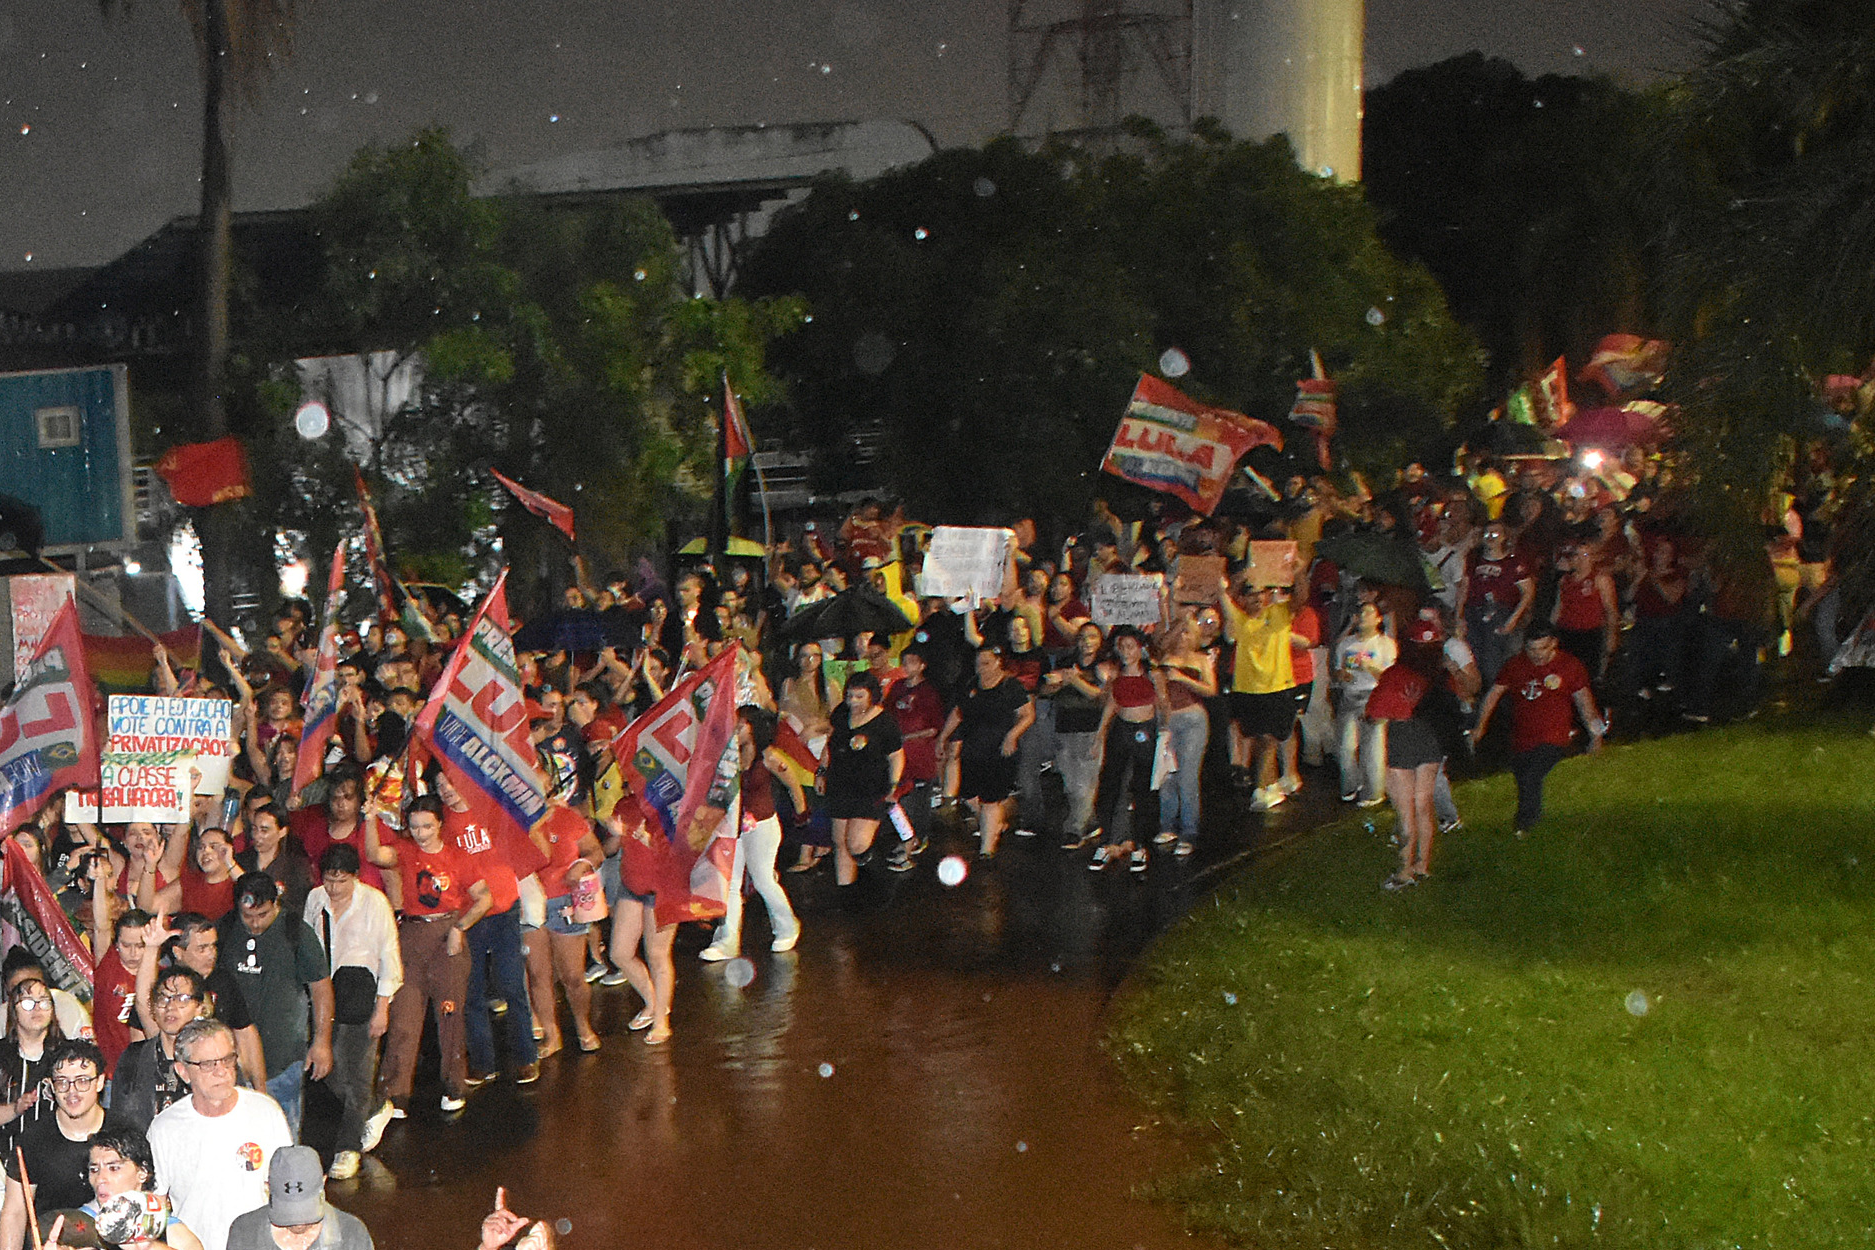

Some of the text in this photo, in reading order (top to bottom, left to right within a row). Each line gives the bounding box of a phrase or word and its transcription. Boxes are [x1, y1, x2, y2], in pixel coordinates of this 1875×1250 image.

[1114, 423, 1216, 470] LULA
[110, 696, 151, 716] APOIE
[448, 653, 540, 769] LUL
[111, 716, 227, 736] VOTE CONTRA A
[102, 766, 177, 787] A CLASSE
[438, 714, 545, 818] VICE ALCKMIN
[18, 905, 94, 1002] SIDENTE
[248, 1148, 263, 1164] 13
